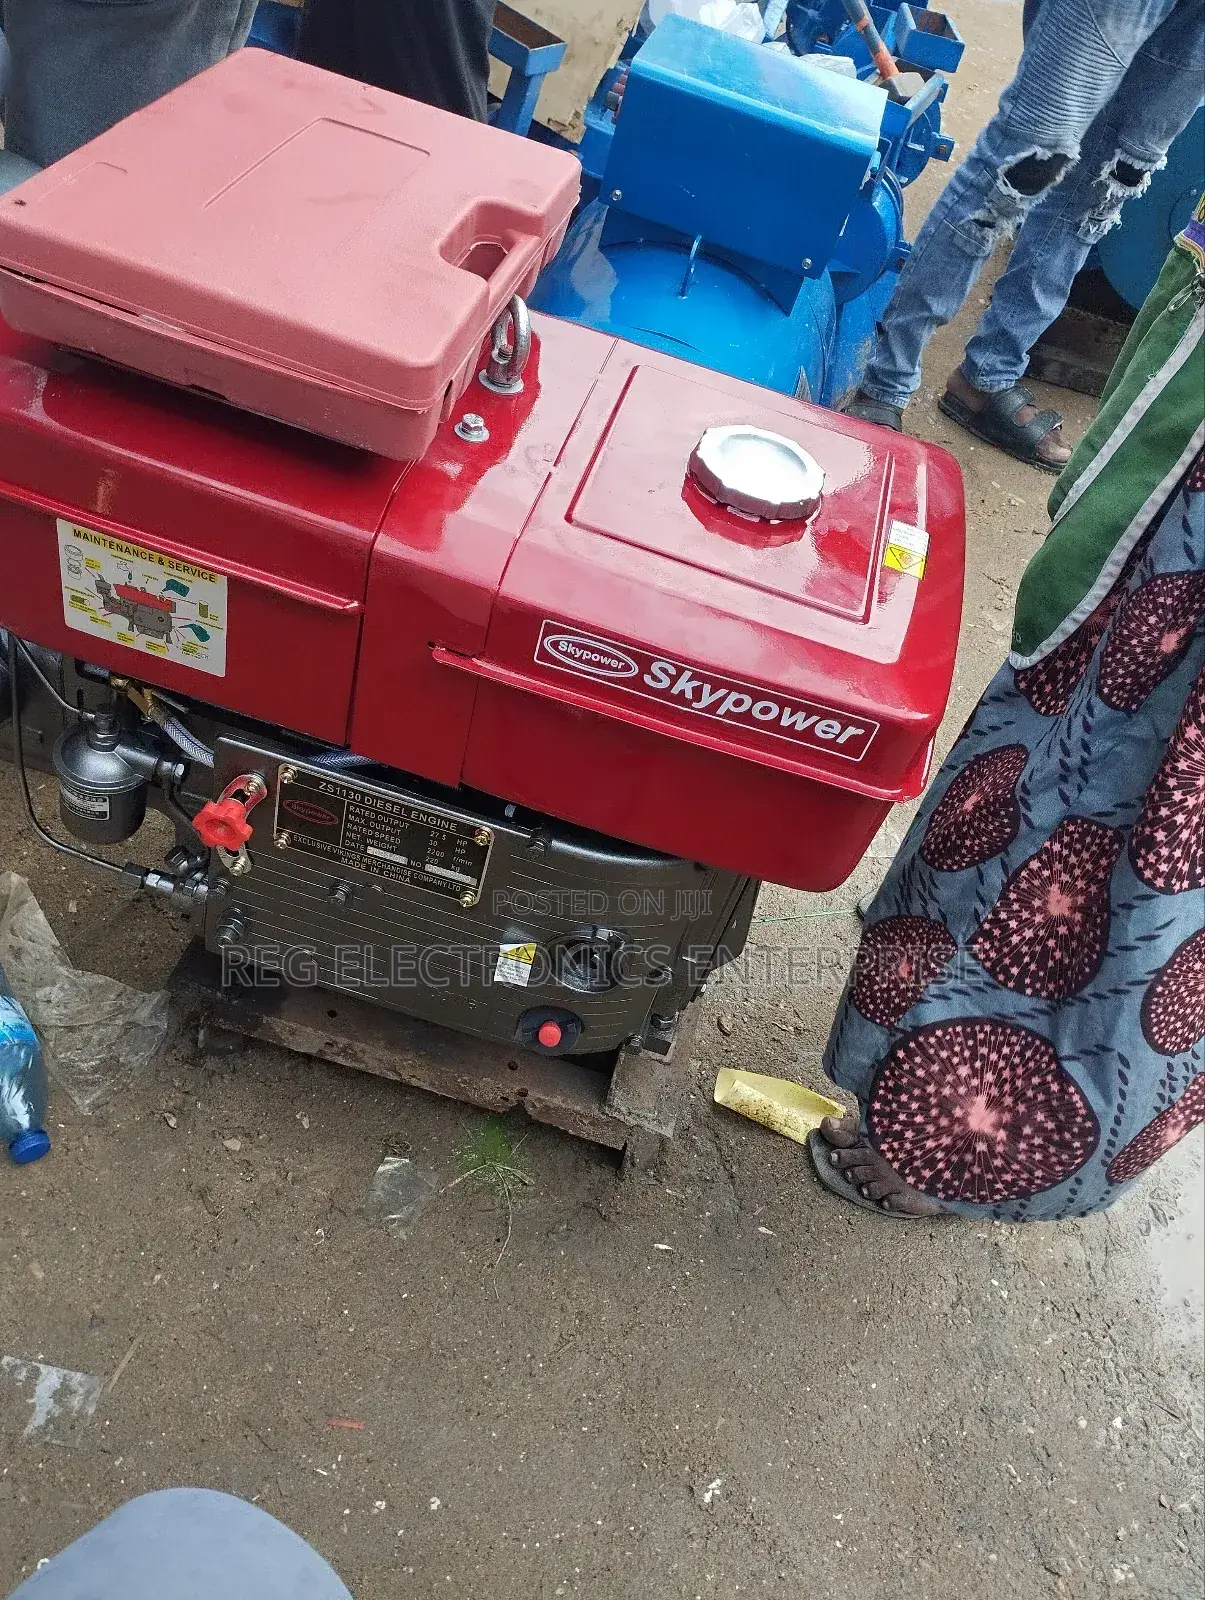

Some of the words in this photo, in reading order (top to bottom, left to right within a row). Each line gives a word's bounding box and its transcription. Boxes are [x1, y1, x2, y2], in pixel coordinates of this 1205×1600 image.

[73, 528, 155, 562] MAINTENANCE
[157, 557, 166, 566] &
[168, 560, 217, 584] SERVICE
[558, 640, 626, 670] Skypower
[643, 661, 865, 745] Skypower
[319, 782, 361, 801] ZS1130
[365, 796, 408, 817] DIESEL
[411, 811, 458, 832] ENGINE
[349, 805, 376, 819] RATED
[377, 814, 410, 829] OUTPUT
[347, 822, 373, 836] RATED
[374, 831, 401, 845] SPEED
[369, 821, 401, 836] OUTPUT
[344, 839, 366, 851] DATE
[366, 838, 398, 852] WEIGHT
[426, 847, 445, 858] 2200
[428, 839, 438, 847] 30
[454, 847, 466, 855] HP
[456, 838, 468, 847] HP
[293, 835, 332, 852] EXCLUSIVE
[333, 847, 361, 861] VIKINGS
[361, 857, 412, 877] MERCHANDISE
[413, 872, 448, 888] COMPANY
[448, 882, 461, 892] LTD
[341, 856, 366, 870] MADE
[370, 865, 380, 874] IN
[383, 870, 411, 884] CHINA
